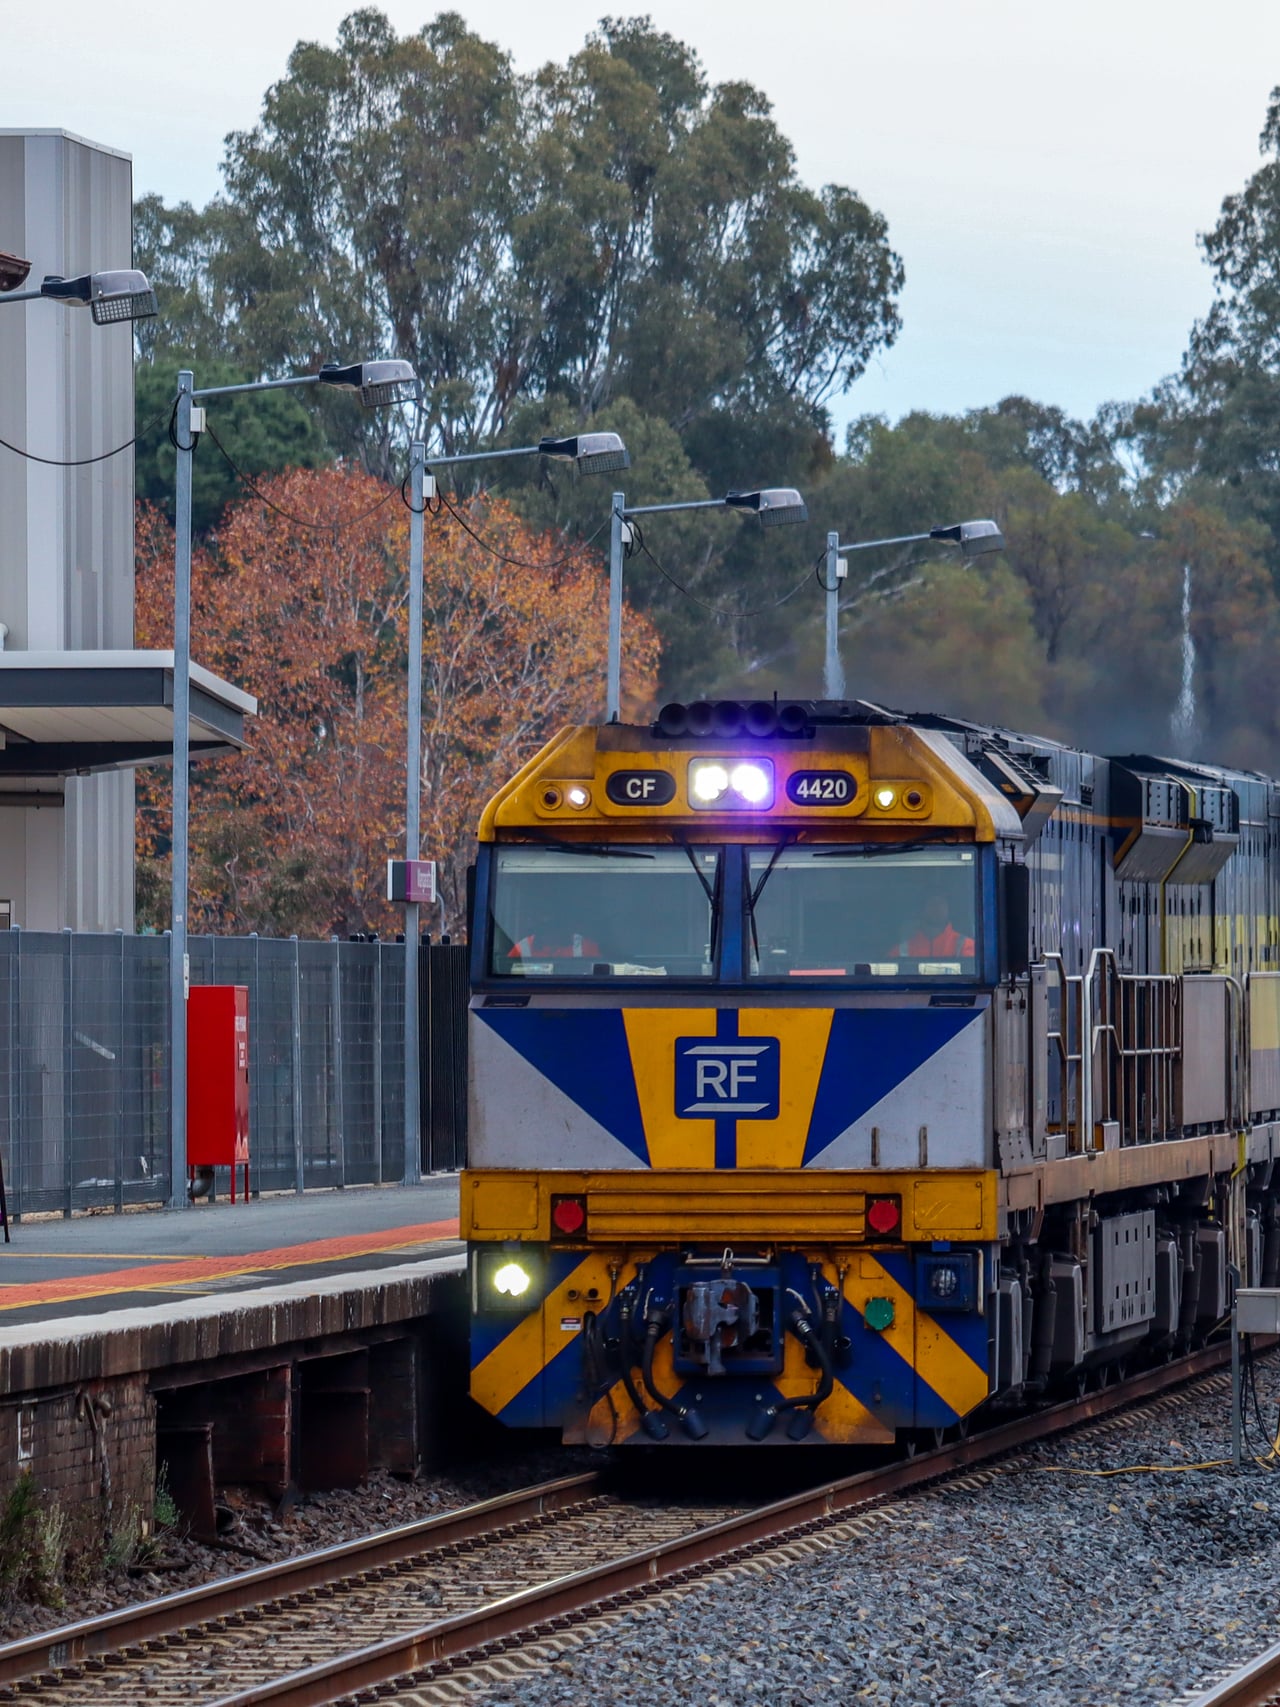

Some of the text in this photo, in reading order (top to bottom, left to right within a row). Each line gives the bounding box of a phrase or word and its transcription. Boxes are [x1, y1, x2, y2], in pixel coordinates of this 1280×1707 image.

[626, 778, 656, 799] CF
[796, 778, 847, 799] 4420
[696, 1060, 758, 1098] RF
